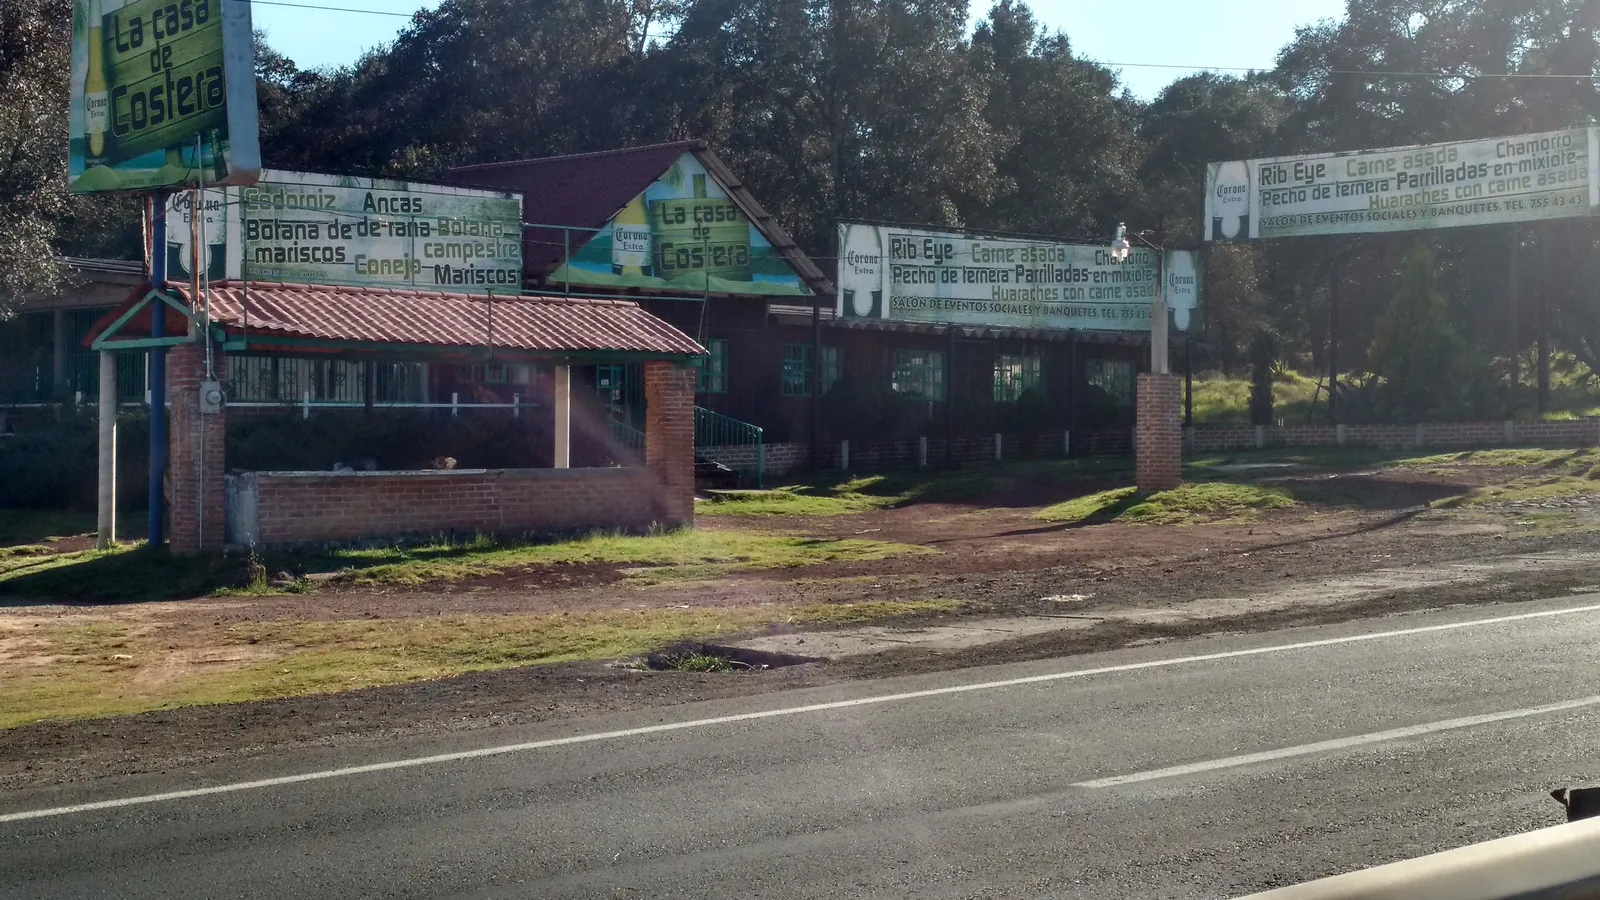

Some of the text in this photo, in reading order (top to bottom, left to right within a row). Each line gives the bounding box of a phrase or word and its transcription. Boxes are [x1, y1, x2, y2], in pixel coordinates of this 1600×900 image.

[114, 0, 209, 53] La casa
[151, 41, 173, 73] de
[111, 66, 226, 138] Costera
[1496, 134, 1572, 158] Chamorro
[1346, 145, 1458, 177] Carne asada
[1261, 162, 1326, 186] Rib Eye
[1397, 162, 1487, 190] Parrilladas
[1217, 183, 1246, 197] Corona
[1262, 179, 1389, 207] Pecho de ternera
[1369, 166, 1588, 211] Huaraches con carne asada
[363, 192, 422, 213] Ancas
[1223, 196, 1242, 204] Extra
[1300, 215, 1313, 224] DE
[1316, 212, 1363, 223] EVENTOS
[1367, 206, 1417, 221] SOCIALES
[1421, 208, 1428, 217] Y
[1530, 198, 1549, 209] 755
[1552, 196, 1566, 207] 43
[1569, 195, 1583, 205] 43
[661, 202, 737, 225] La casa
[247, 218, 352, 240] Botana de
[357, 216, 380, 237] de
[438, 216, 504, 237] Botana
[615, 226, 648, 242] Corona
[692, 222, 710, 240] de
[255, 241, 346, 264] mariscos
[424, 238, 519, 263] campestre
[623, 241, 644, 250] Extra
[891, 238, 953, 265] Rib Eye
[972, 243, 1065, 263] Carne asada
[355, 253, 422, 279] Conejo
[847, 250, 878, 266] Corona
[434, 264, 517, 285] Mariscos
[854, 266, 874, 274] Extra
[893, 266, 1008, 284] Pecho de ternera
[1015, 264, 1088, 284] Parrilladas
[1169, 274, 1194, 287] Corona
[991, 285, 1058, 302] Huaraches
[1063, 287, 1085, 300] con
[1089, 286, 1122, 299] carne
[929, 299, 942, 310] DE
[945, 300, 987, 311] EVENTOS
[989, 302, 1032, 314] SOCIALES
[1036, 306, 1042, 314] Y
[1121, 310, 1134, 318] 755
[1136, 310, 1146, 319] 43
